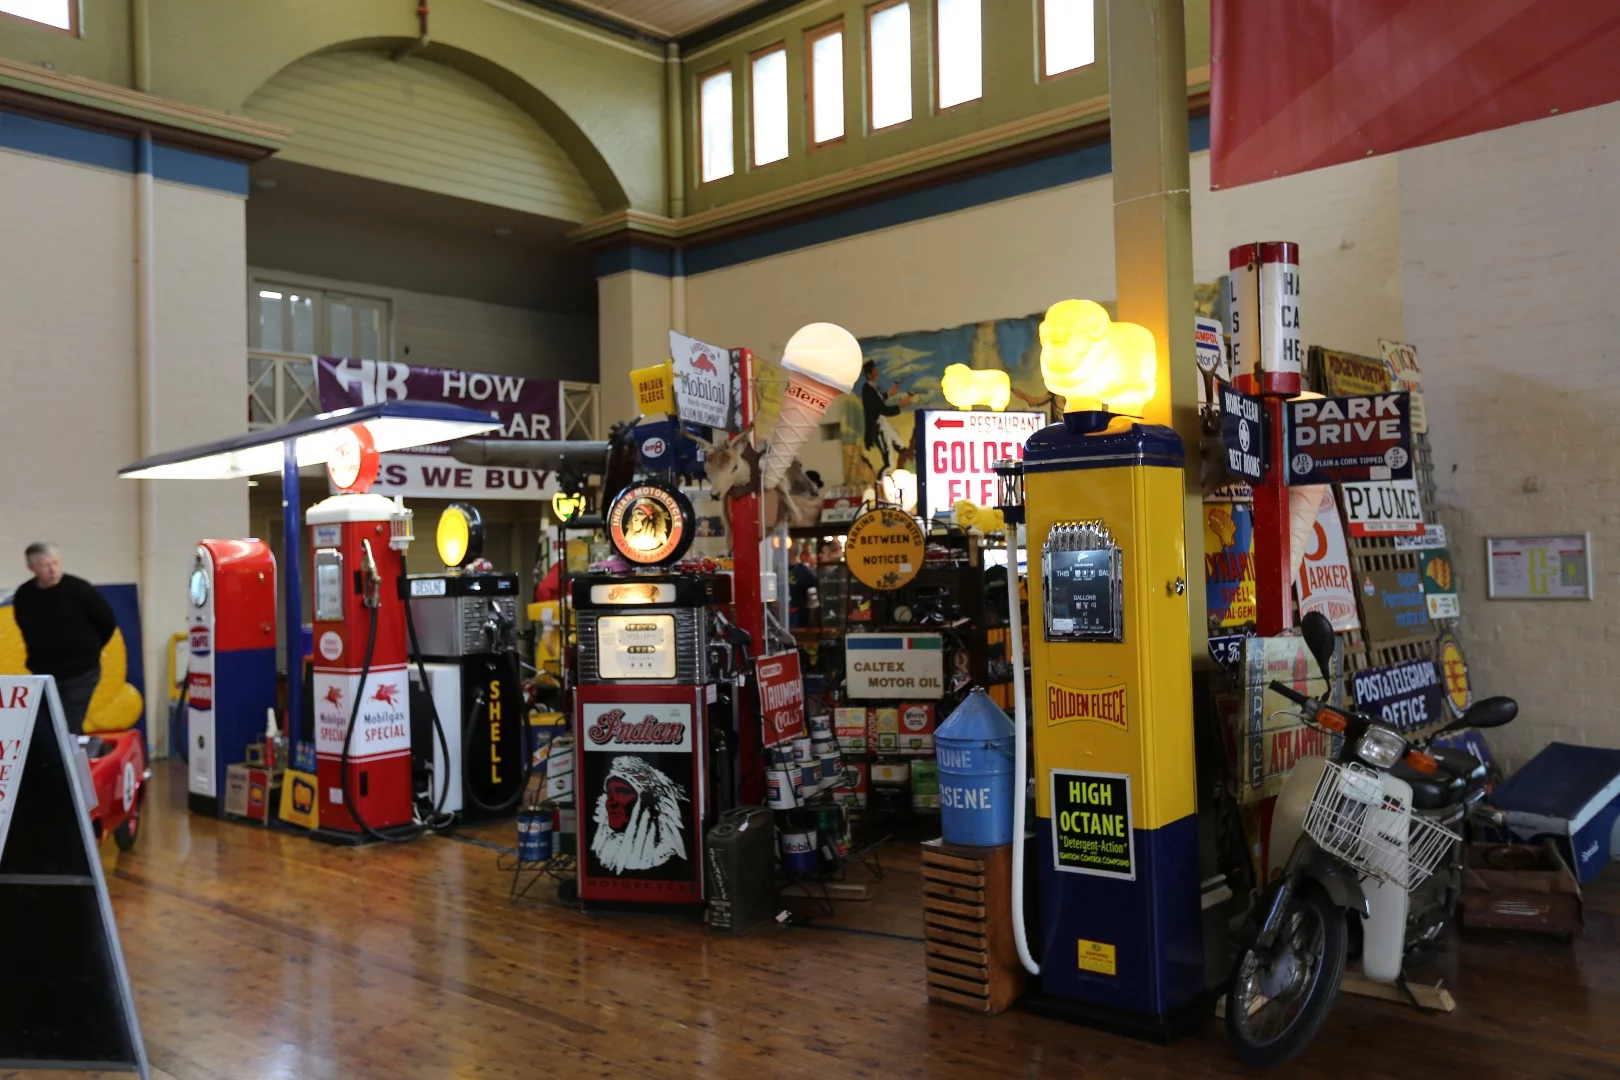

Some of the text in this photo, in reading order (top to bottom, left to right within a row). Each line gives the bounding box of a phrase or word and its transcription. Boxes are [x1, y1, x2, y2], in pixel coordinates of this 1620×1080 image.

[442, 372, 525, 403] HOW
[639, 378, 664, 393] GOLDEN
[640, 389, 665, 405] FLEECE
[680, 371, 726, 405] Mobiloil
[784, 381, 827, 410] eters
[1294, 394, 1401, 424] PARK
[969, 415, 1041, 433] RESTAURANT
[1295, 418, 1402, 447] DRIVE
[1315, 459, 1334, 468] PLAIN
[1340, 457, 1358, 466] CORK
[421, 466, 473, 488] WE
[485, 469, 551, 490] BUY
[612, 486, 682, 529] INDIAN MOTORCYCLE
[1345, 486, 1421, 520] PLUME
[848, 514, 876, 550] PARKING
[860, 534, 910, 545] BETWEEN
[863, 554, 909, 565] NOTICES
[1098, 569, 1109, 577] SAL
[853, 662, 905, 672] CALTEX
[760, 679, 803, 712] TRIUMPH
[868, 677, 941, 688] MOTOR OIL
[363, 711, 405, 725] Mobilgas
[1049, 686, 1126, 726] GOLDEN FLEECE
[1381, 694, 1429, 728] OFFICE
[365, 724, 406, 743] SPECIAL
[488, 679, 502, 784] SHELL
[588, 708, 685, 745] Indian
[1068, 781, 1112, 806] HIGH
[1059, 810, 1125, 838] OCTANE
[1080, 854, 1102, 864] CONTROL
[1102, 856, 1131, 868] COMPOUND
